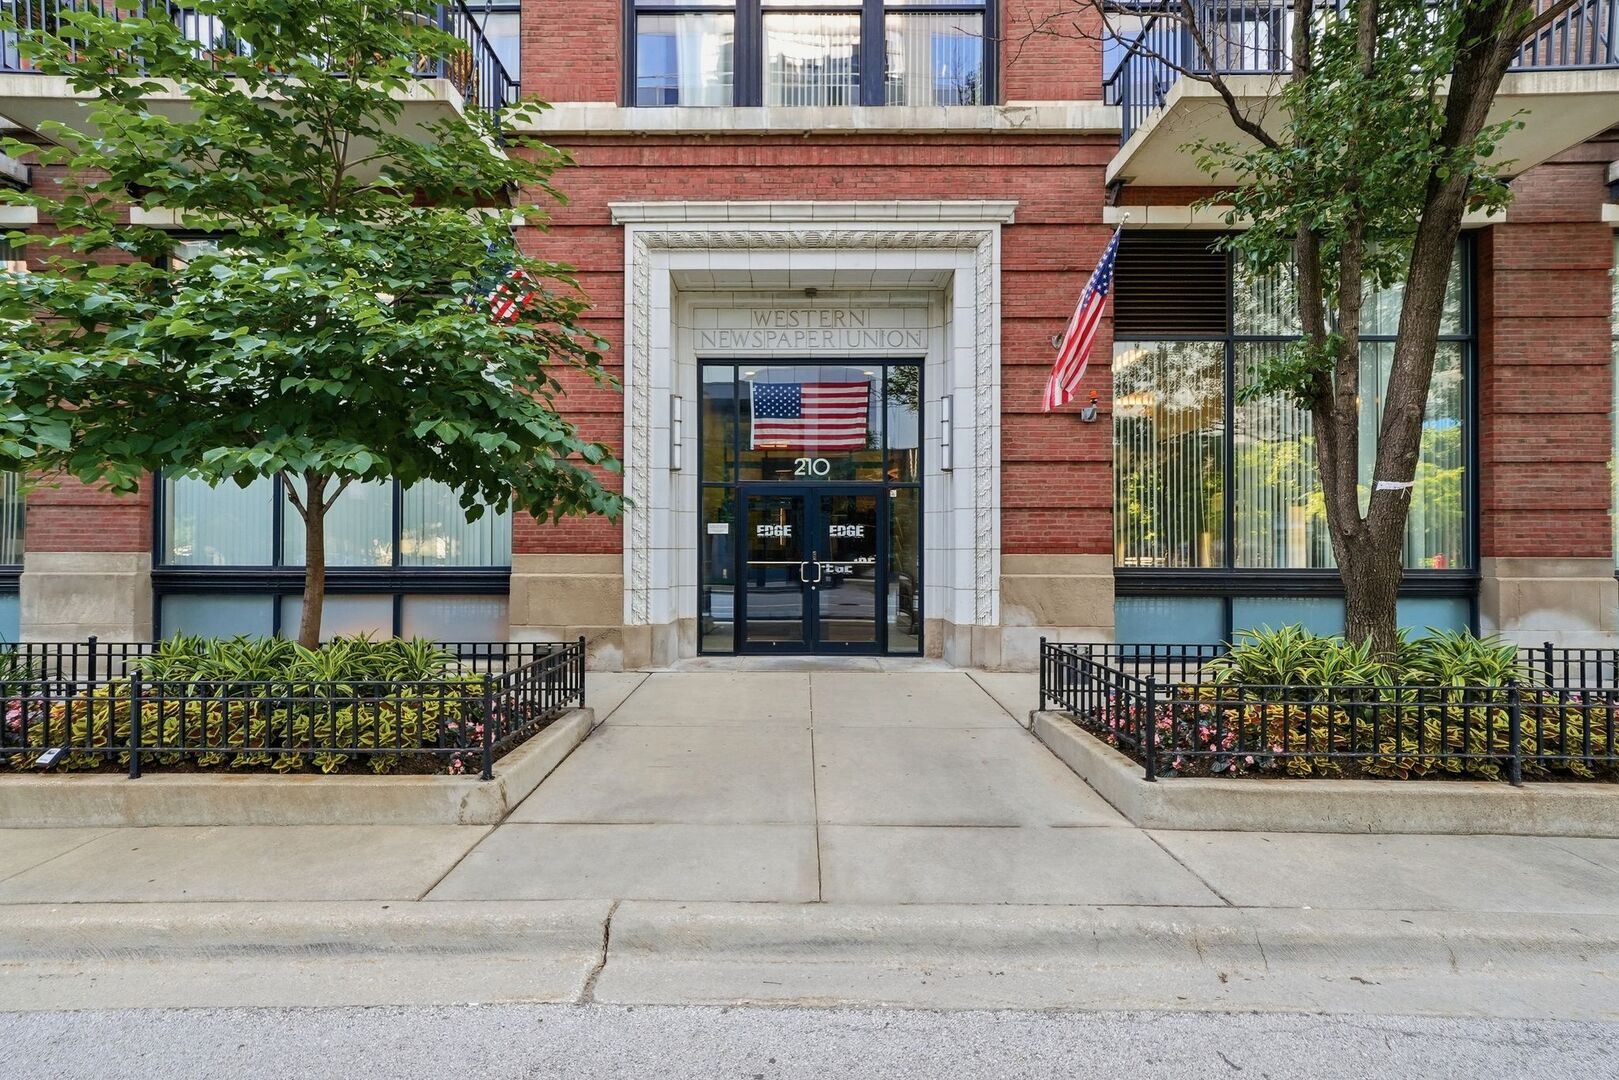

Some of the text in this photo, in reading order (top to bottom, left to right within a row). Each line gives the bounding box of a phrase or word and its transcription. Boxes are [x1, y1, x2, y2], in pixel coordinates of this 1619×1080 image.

[753, 310, 866, 328] WESTERN
[701, 329, 922, 348] NEWSPAPER UNION
[794, 457, 831, 476] 210
[756, 524, 792, 537] EDGE
[829, 524, 865, 537] EDGE
